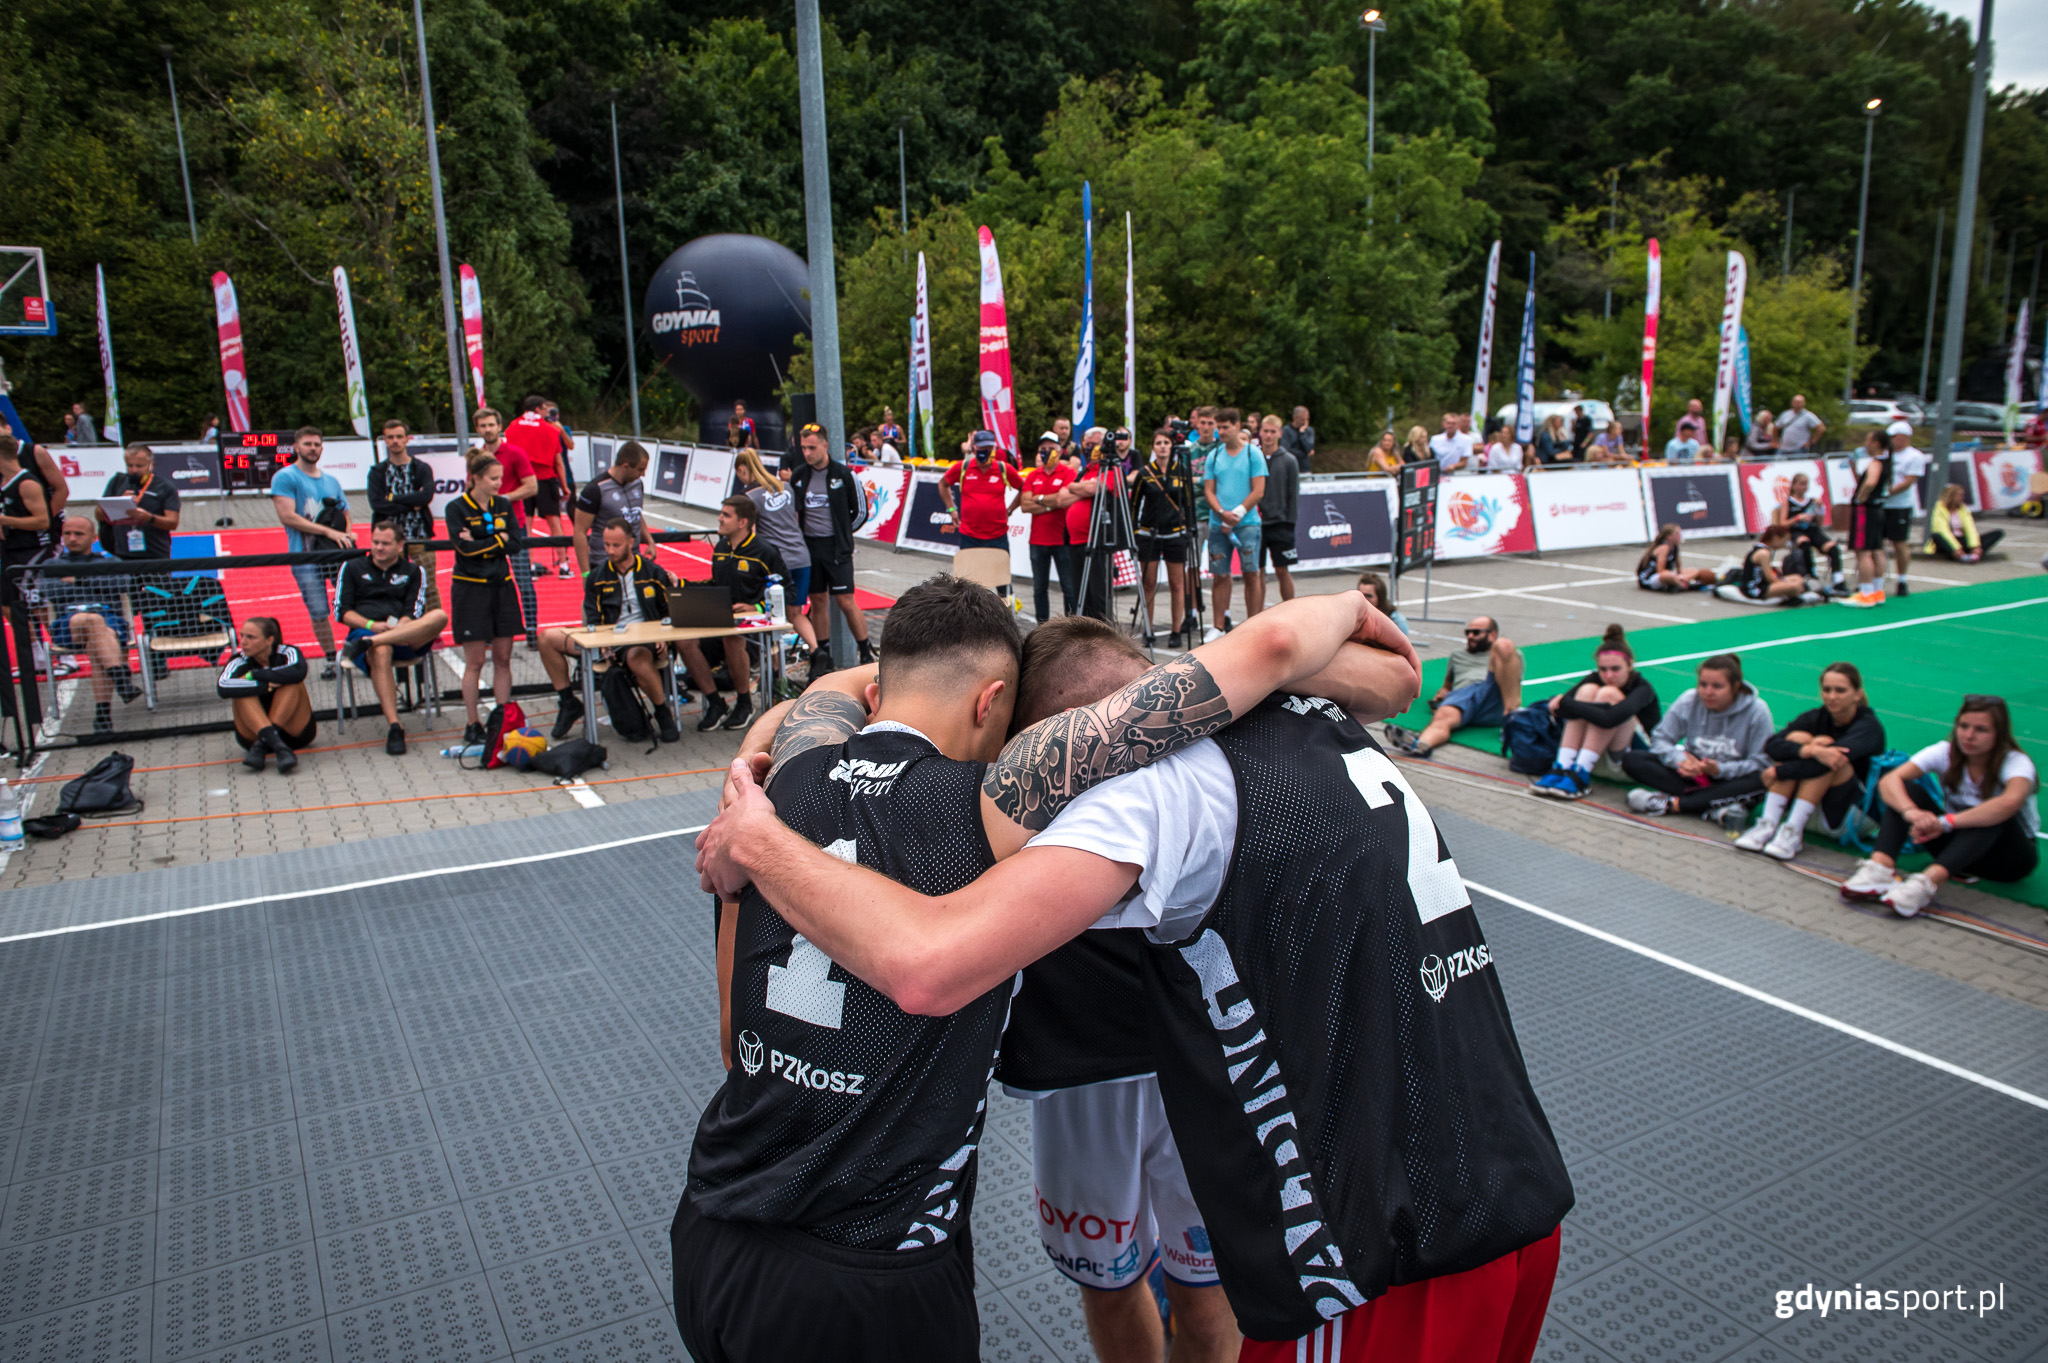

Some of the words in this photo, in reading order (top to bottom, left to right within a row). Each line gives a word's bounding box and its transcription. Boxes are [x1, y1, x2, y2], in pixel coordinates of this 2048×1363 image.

[652, 309, 720, 334] GDYNIA
[681, 326, 720, 348] sport
[1308, 523, 1352, 539] GDYNIA
[1340, 746, 1472, 925] 2
[770, 1048, 865, 1095] PZKOSZ
[1041, 1239, 1104, 1277] ONAL
